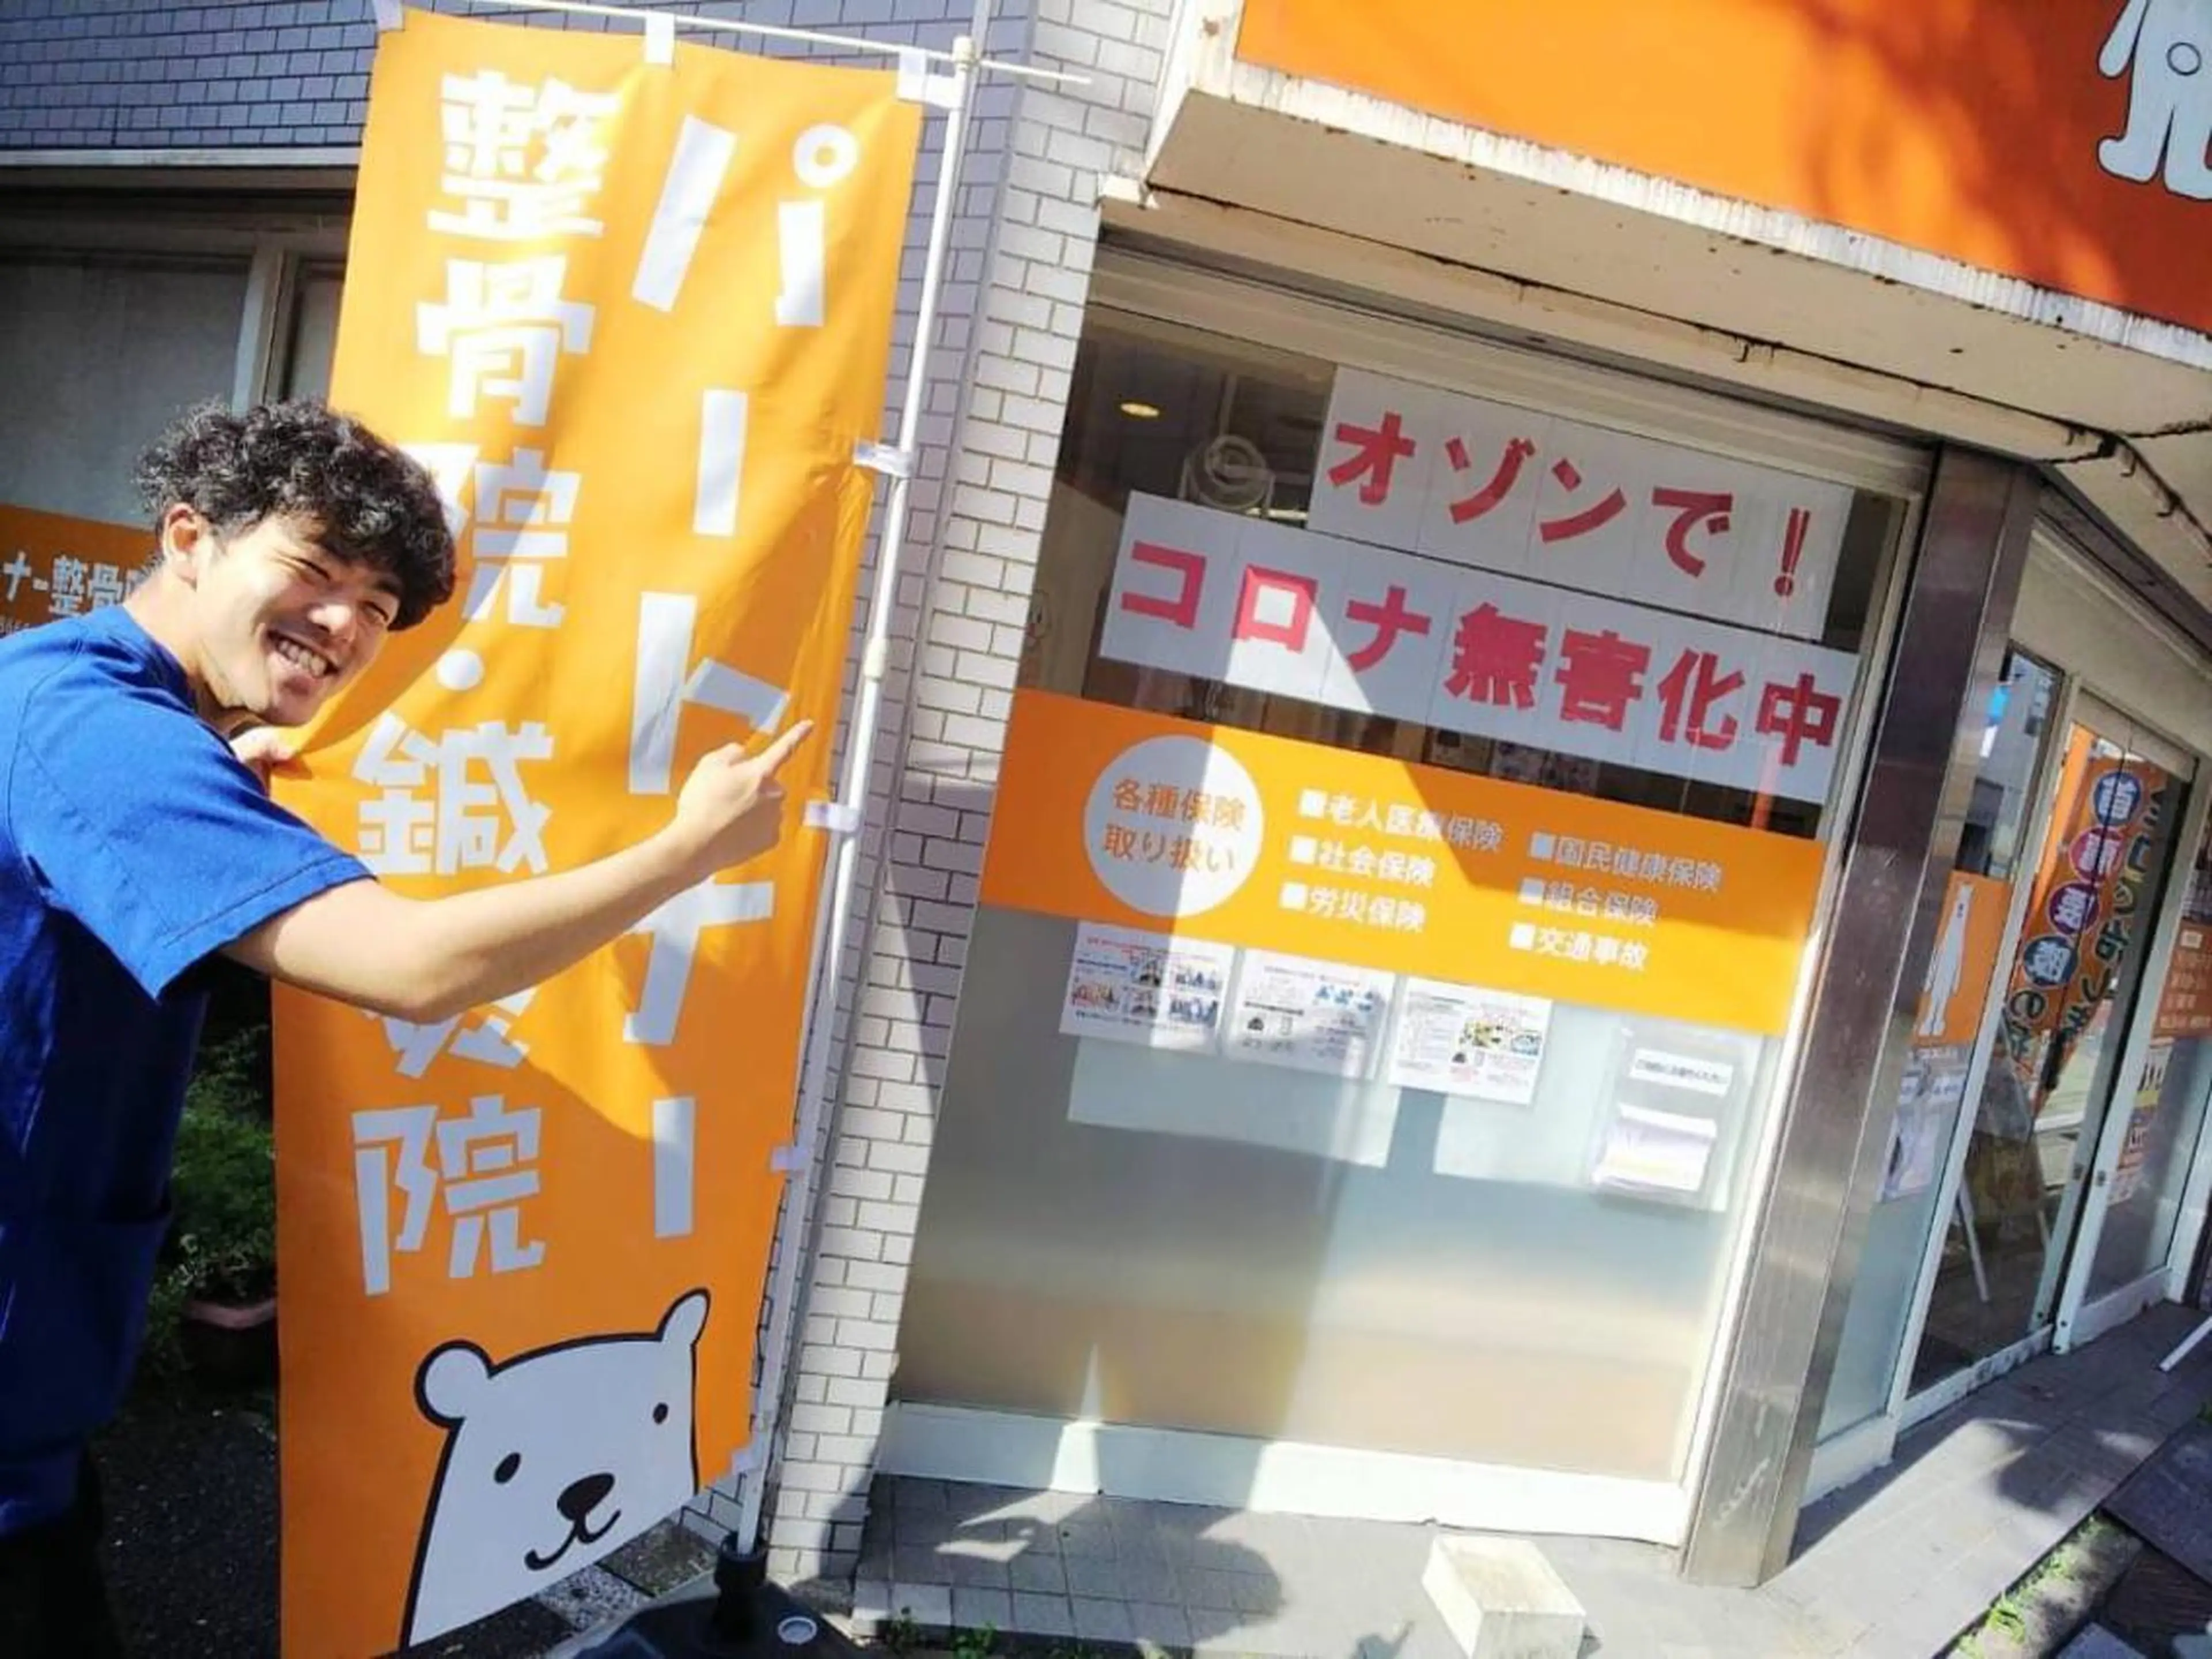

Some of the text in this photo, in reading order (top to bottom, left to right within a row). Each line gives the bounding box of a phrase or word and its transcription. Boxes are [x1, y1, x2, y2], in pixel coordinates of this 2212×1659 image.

[623, 112, 859, 1240] パートナー
[1120, 539, 1842, 766] コロナ無害化中
[1113, 778, 1245, 832] 各種保険
[1325, 793, 1503, 854] 老人医療保険
[1101, 823, 1234, 873] 取り扱い
[1317, 840, 1437, 887] 社会保険
[1556, 835, 1722, 893] 国民健康保険
[1308, 887, 1426, 933] 労災保険
[1543, 879, 1659, 927] 組合保険
[1535, 925, 1649, 970] 交通事故
